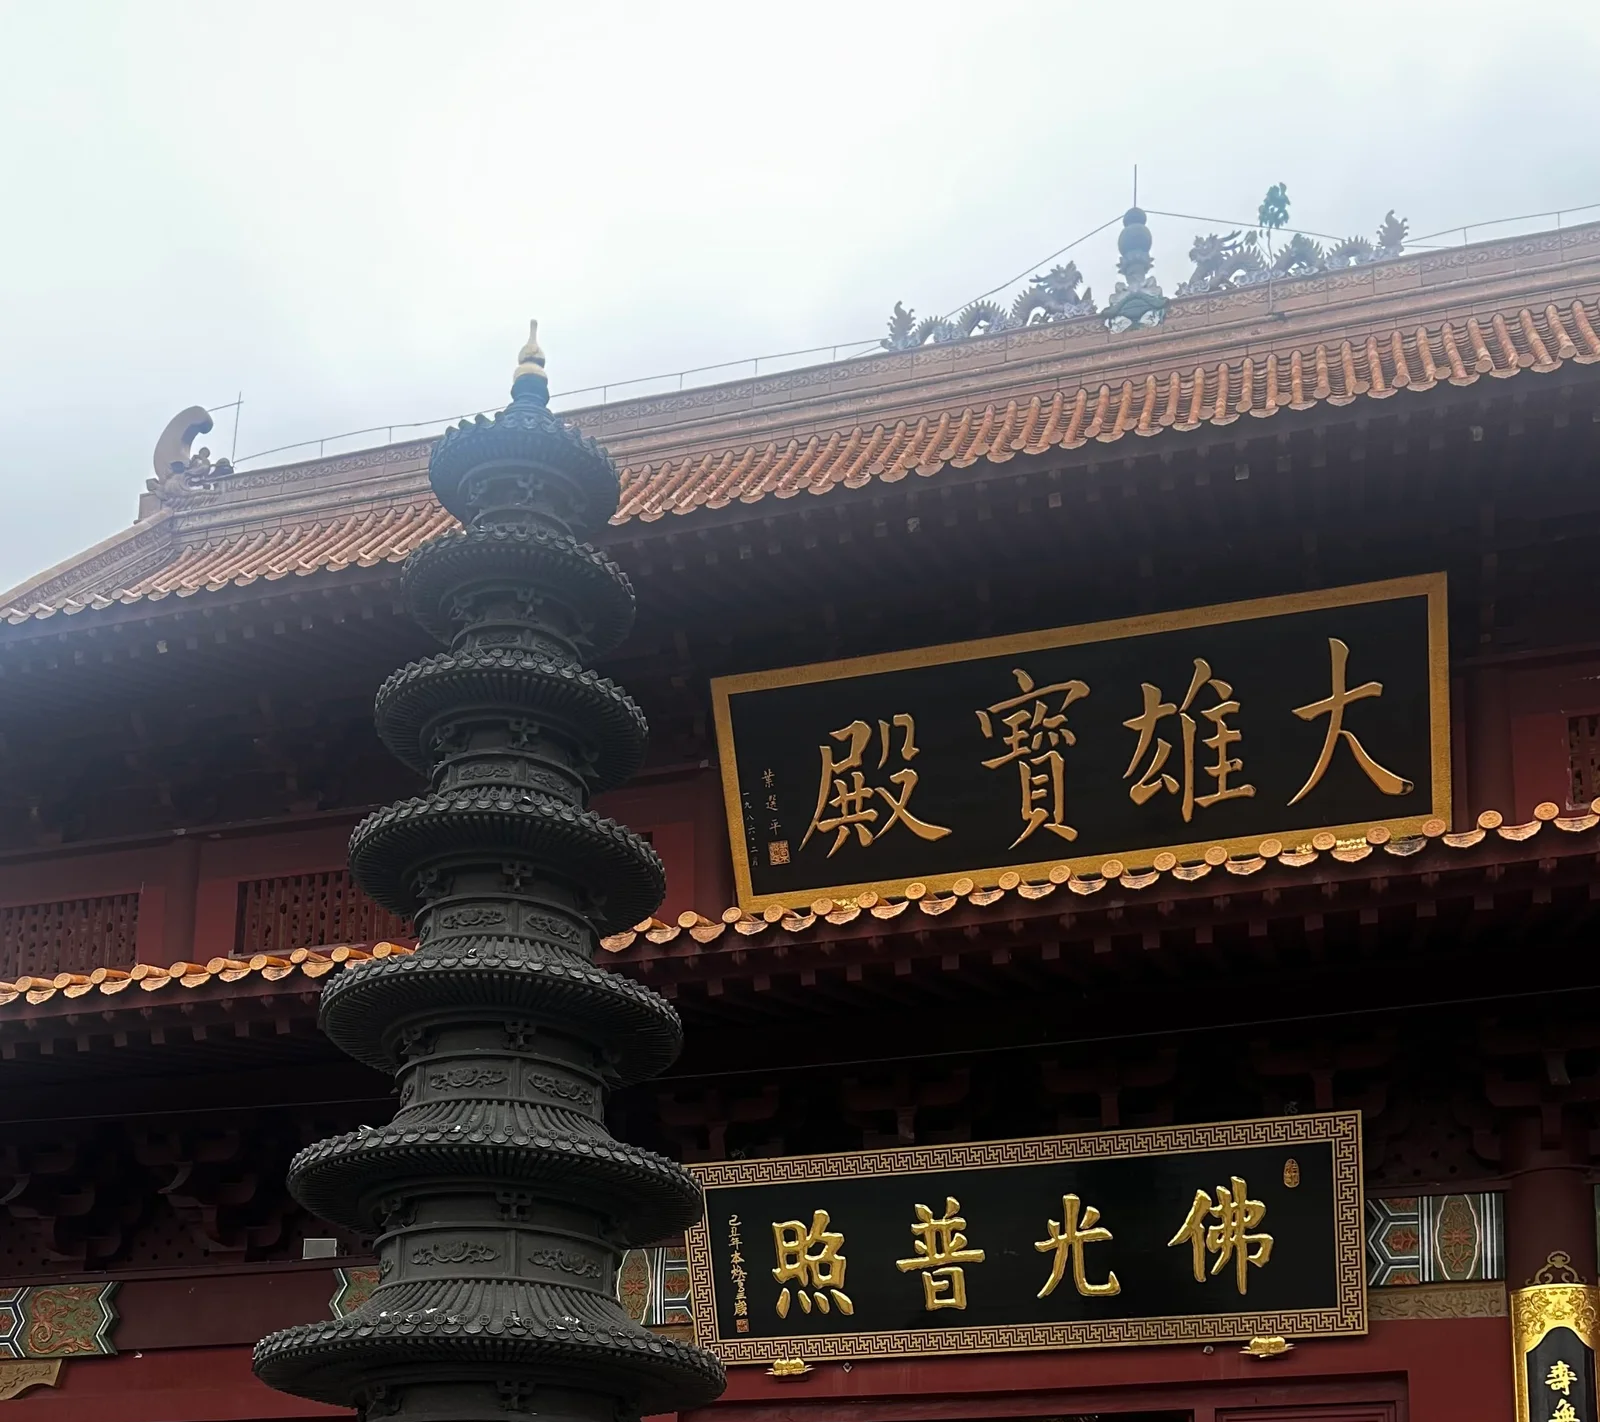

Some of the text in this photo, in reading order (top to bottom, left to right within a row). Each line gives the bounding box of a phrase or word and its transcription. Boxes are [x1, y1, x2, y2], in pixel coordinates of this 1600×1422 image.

[761, 768, 782, 836] 葉選平
[799, 637, 1414, 859] 大雄寶殿
[771, 1175, 1275, 1319] 佛光普照
